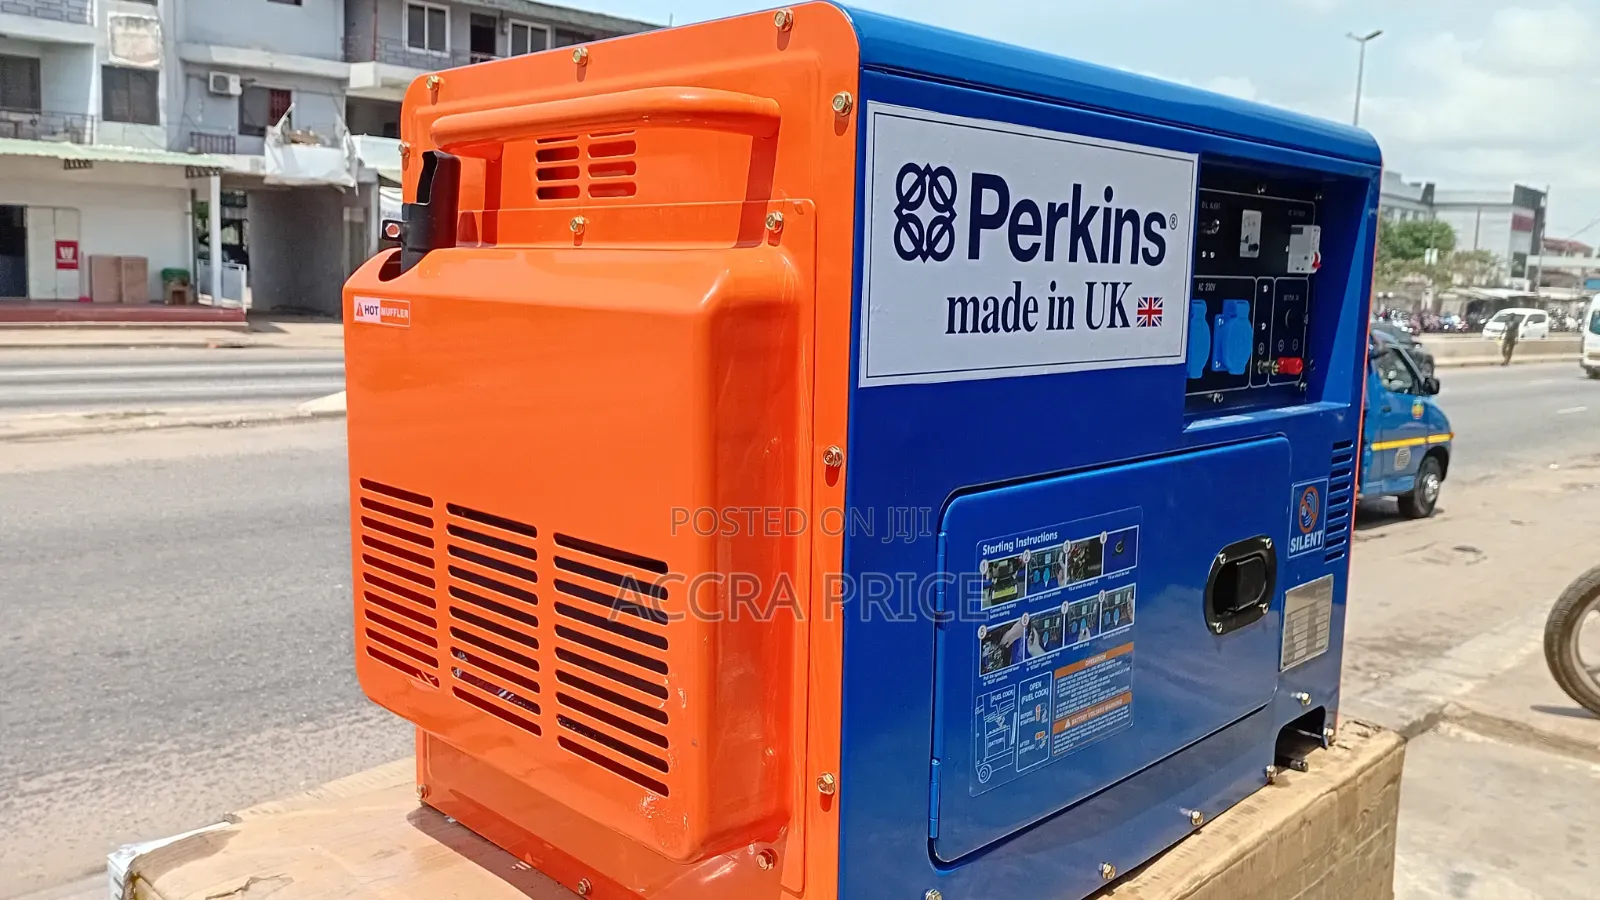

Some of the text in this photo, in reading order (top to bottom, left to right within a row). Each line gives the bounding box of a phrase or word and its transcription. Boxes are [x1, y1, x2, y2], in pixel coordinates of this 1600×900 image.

[364, 304, 409, 319] HOT MUFFLER
[944, 280, 1133, 335] made in UK
[982, 531, 1058, 556] Starting Instructions
[1290, 530, 1323, 553] SILENT
[1029, 681, 1042, 691] OPEN
